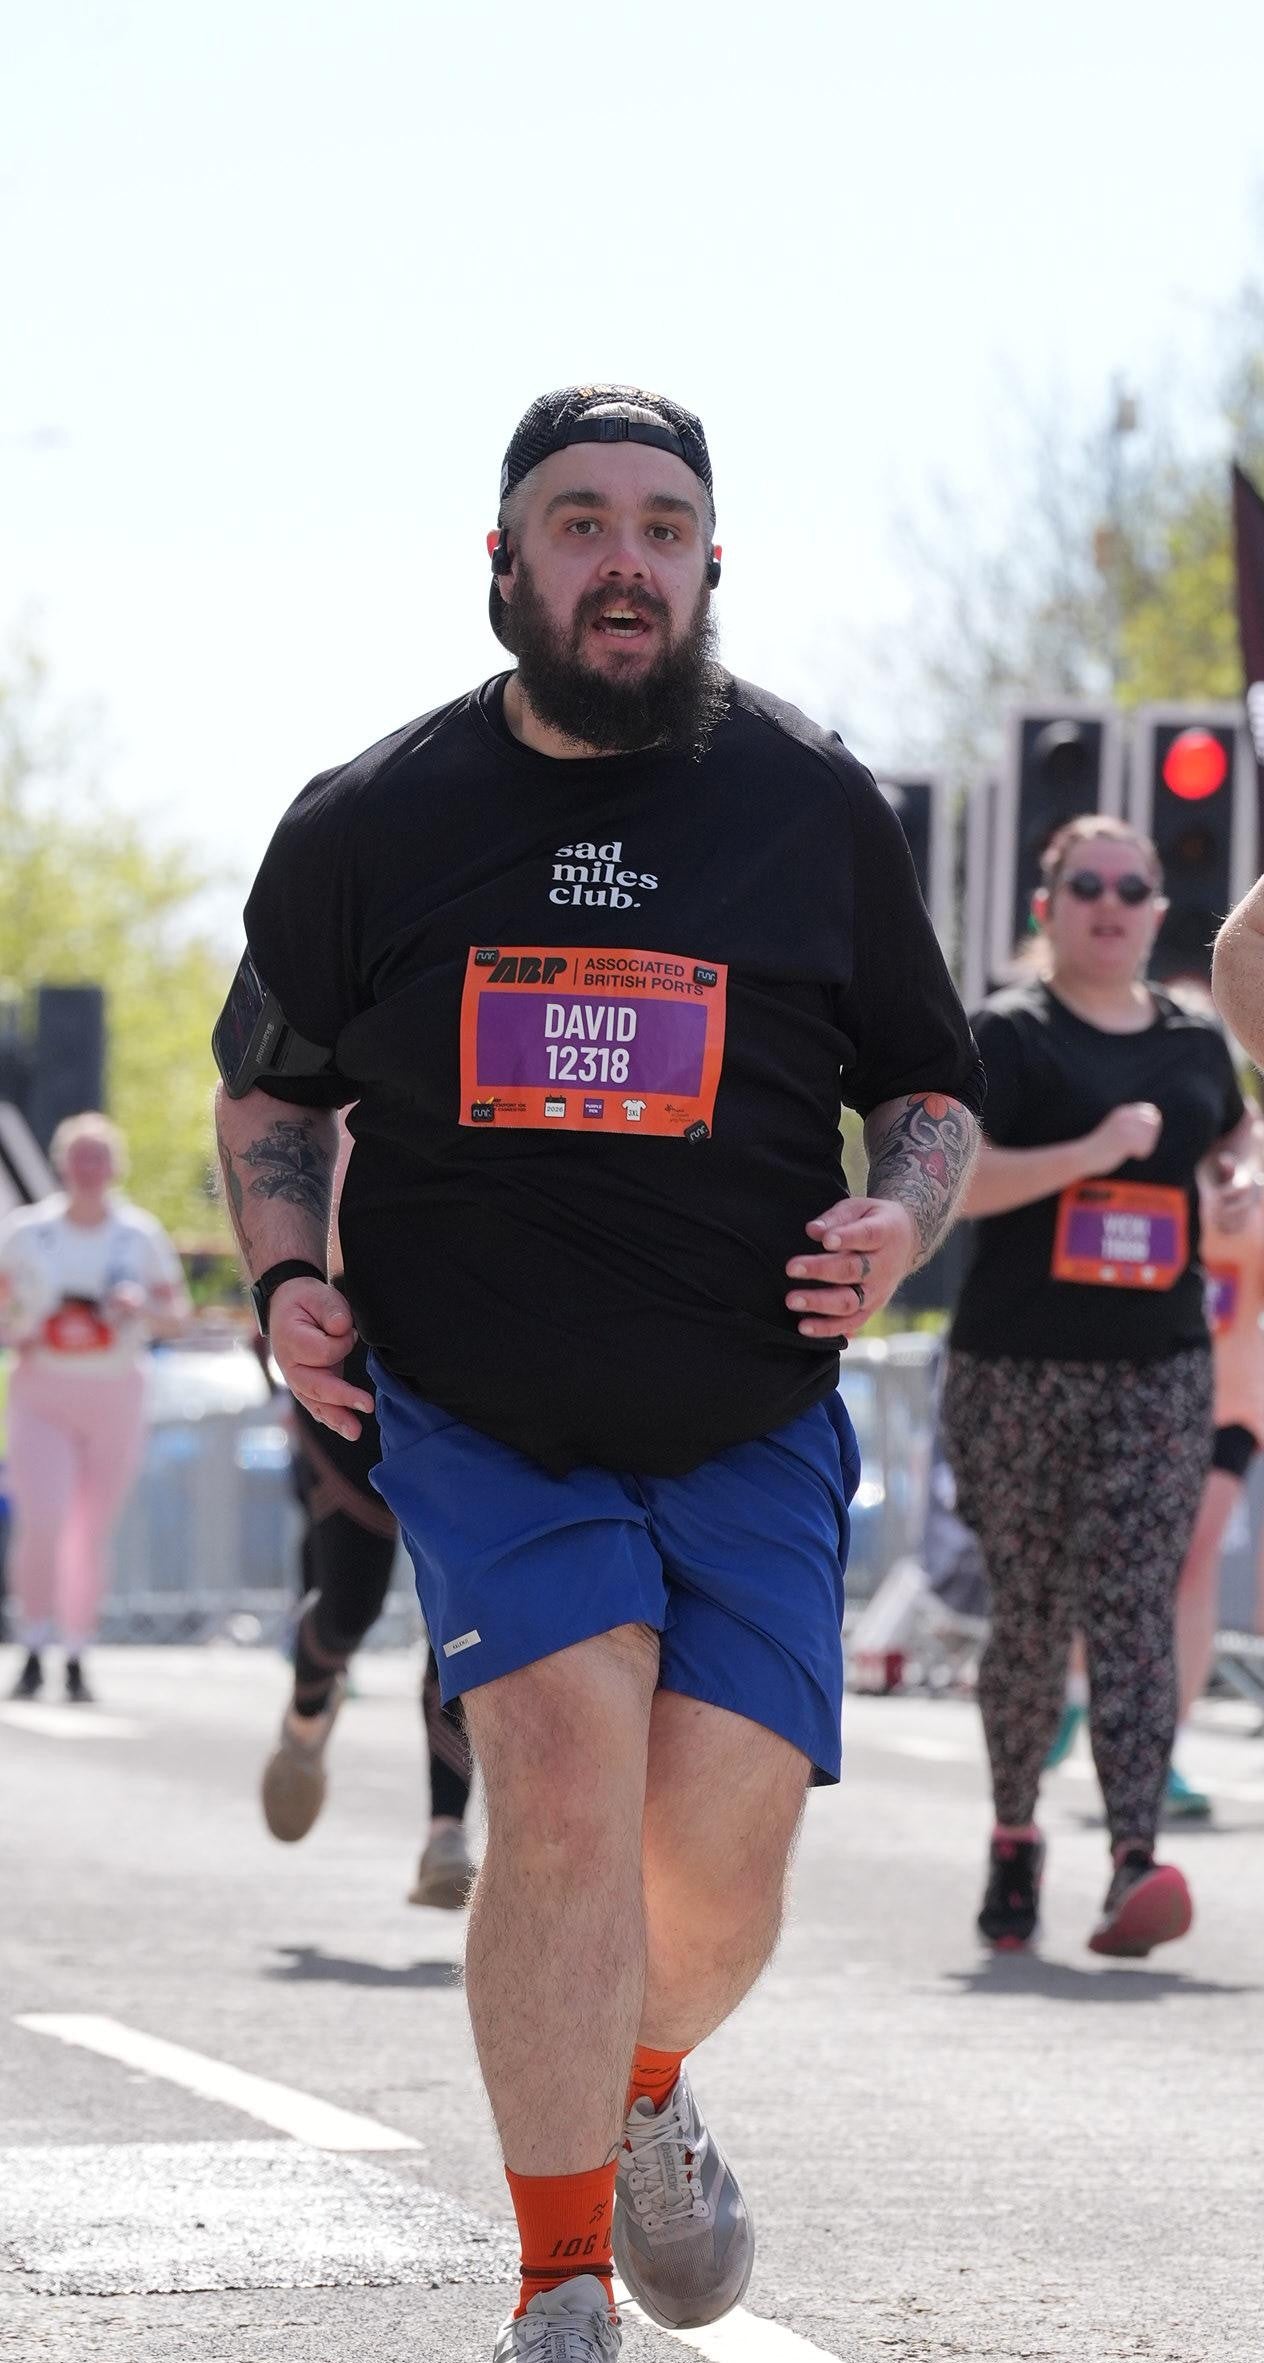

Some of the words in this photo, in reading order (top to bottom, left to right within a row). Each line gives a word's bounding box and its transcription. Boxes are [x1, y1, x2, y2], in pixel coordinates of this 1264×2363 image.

[554, 841, 623, 863] sad
[551, 861, 659, 890] miles
[549, 884, 641, 909] club.
[486, 957, 568, 984] ABP
[584, 957, 685, 977] ASSOCIATED
[583, 973, 646, 989] BRITISH
[651, 978, 704, 996] PORTS
[544, 1003, 637, 1042] DAVID
[545, 1045, 630, 1084] 12318
[547, 1105, 564, 1113] 2026
